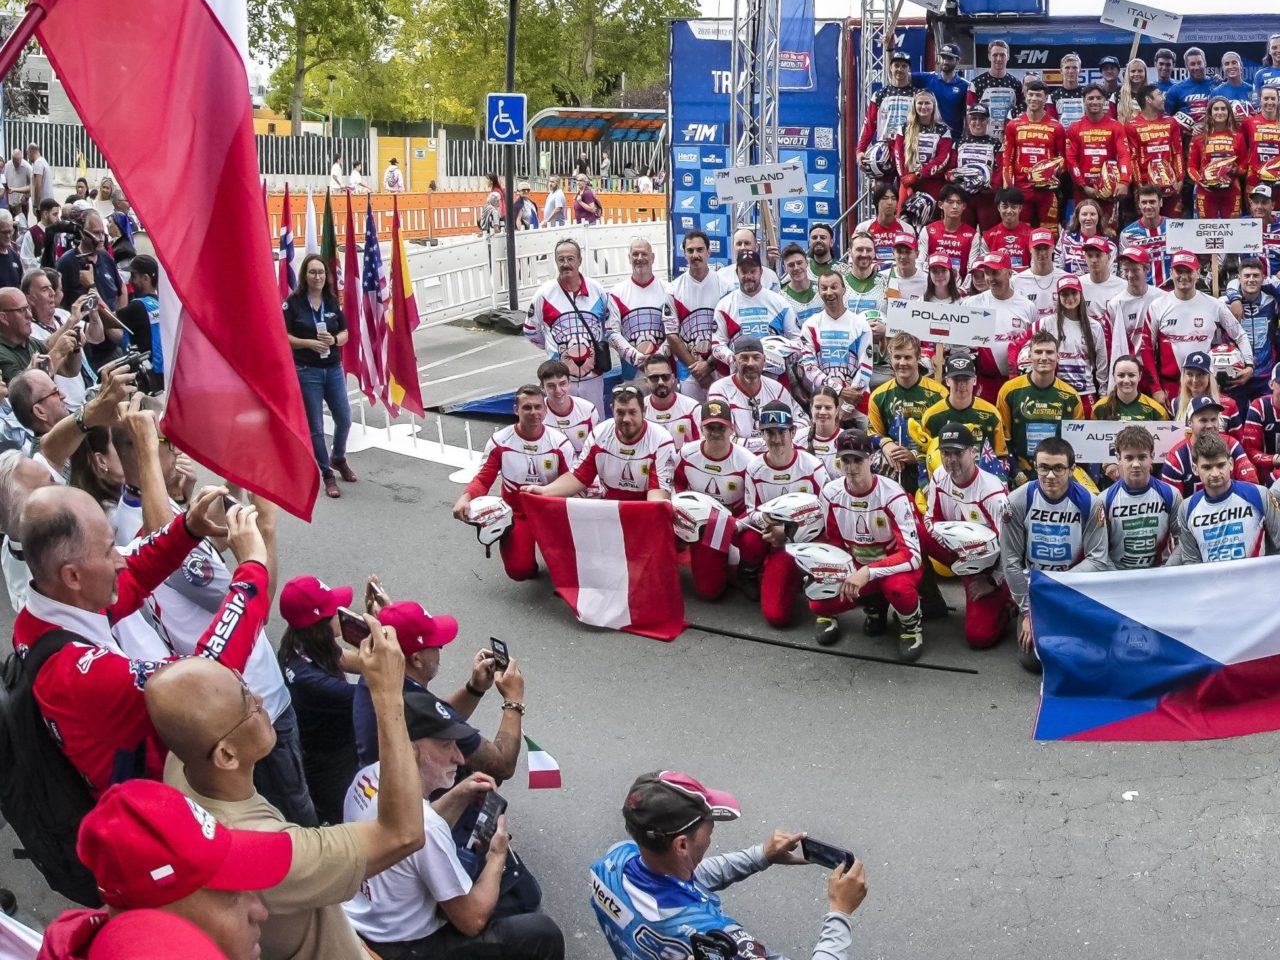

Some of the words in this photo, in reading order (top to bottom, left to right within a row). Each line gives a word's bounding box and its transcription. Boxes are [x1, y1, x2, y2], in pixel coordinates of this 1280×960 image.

[1127, 6, 1158, 21] ITALY
[1013, 49, 1049, 64] FIM
[682, 124, 719, 142] FIM
[1027, 132, 1049, 140] SPEA
[1149, 131, 1170, 139] SPEA
[1029, 156, 1038, 164] 3
[734, 172, 785, 185] IRELAND
[1169, 222, 1185, 230] FIM
[1198, 223, 1231, 231] GREAT
[890, 300, 907, 308] FIM
[911, 309, 970, 324] POLAND
[742, 324, 768, 335] 248
[821, 349, 848, 359] 247
[1065, 424, 1085, 432] FIM
[1112, 501, 1167, 518] CZECHIA
[1030, 508, 1081, 524] ZECHIA
[1193, 505, 1253, 527] CZECHIA
[1036, 547, 1067, 558] 219
[592, 878, 622, 917] Hertz
